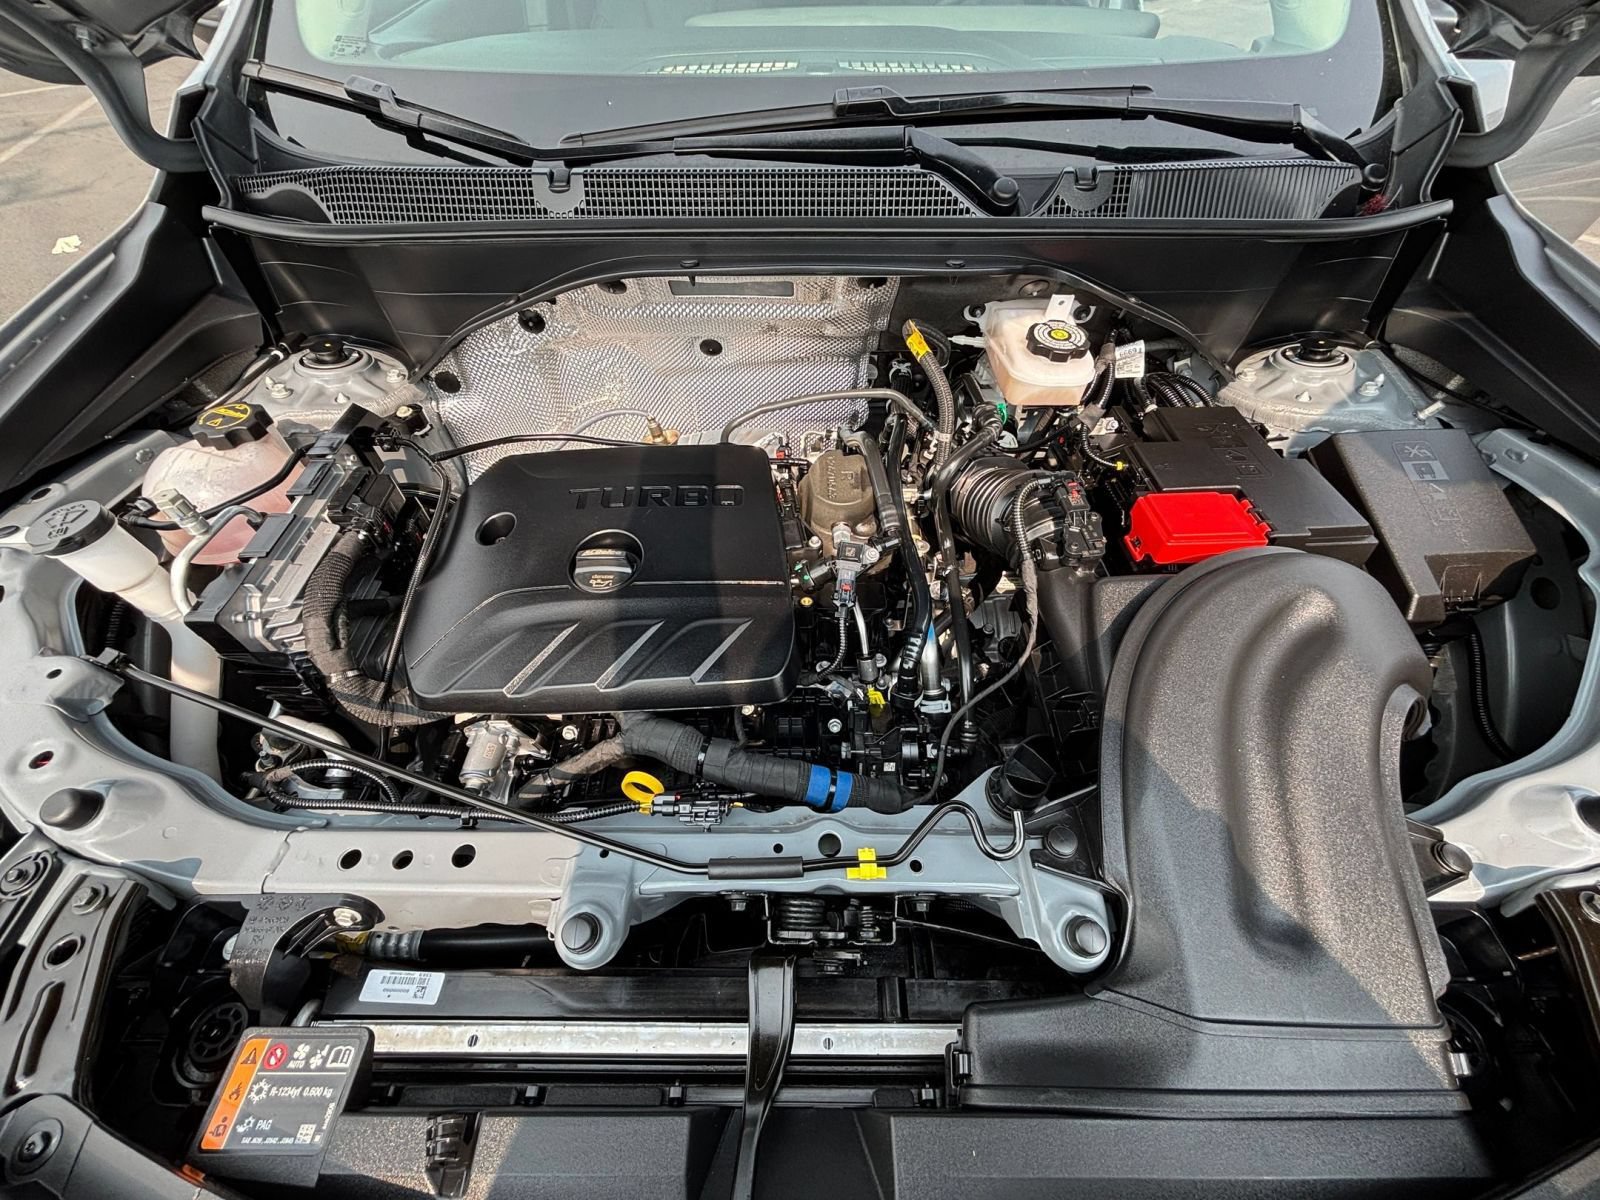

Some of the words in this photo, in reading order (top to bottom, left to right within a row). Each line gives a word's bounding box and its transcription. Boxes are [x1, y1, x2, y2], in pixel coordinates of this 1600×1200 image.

[569, 484, 745, 510] TURBO
[287, 1060, 305, 1068] AUTO
[269, 1086, 302, 1098] R-1234yf
[323, 1086, 333, 1099] kg
[255, 1119, 272, 1130] PAG
